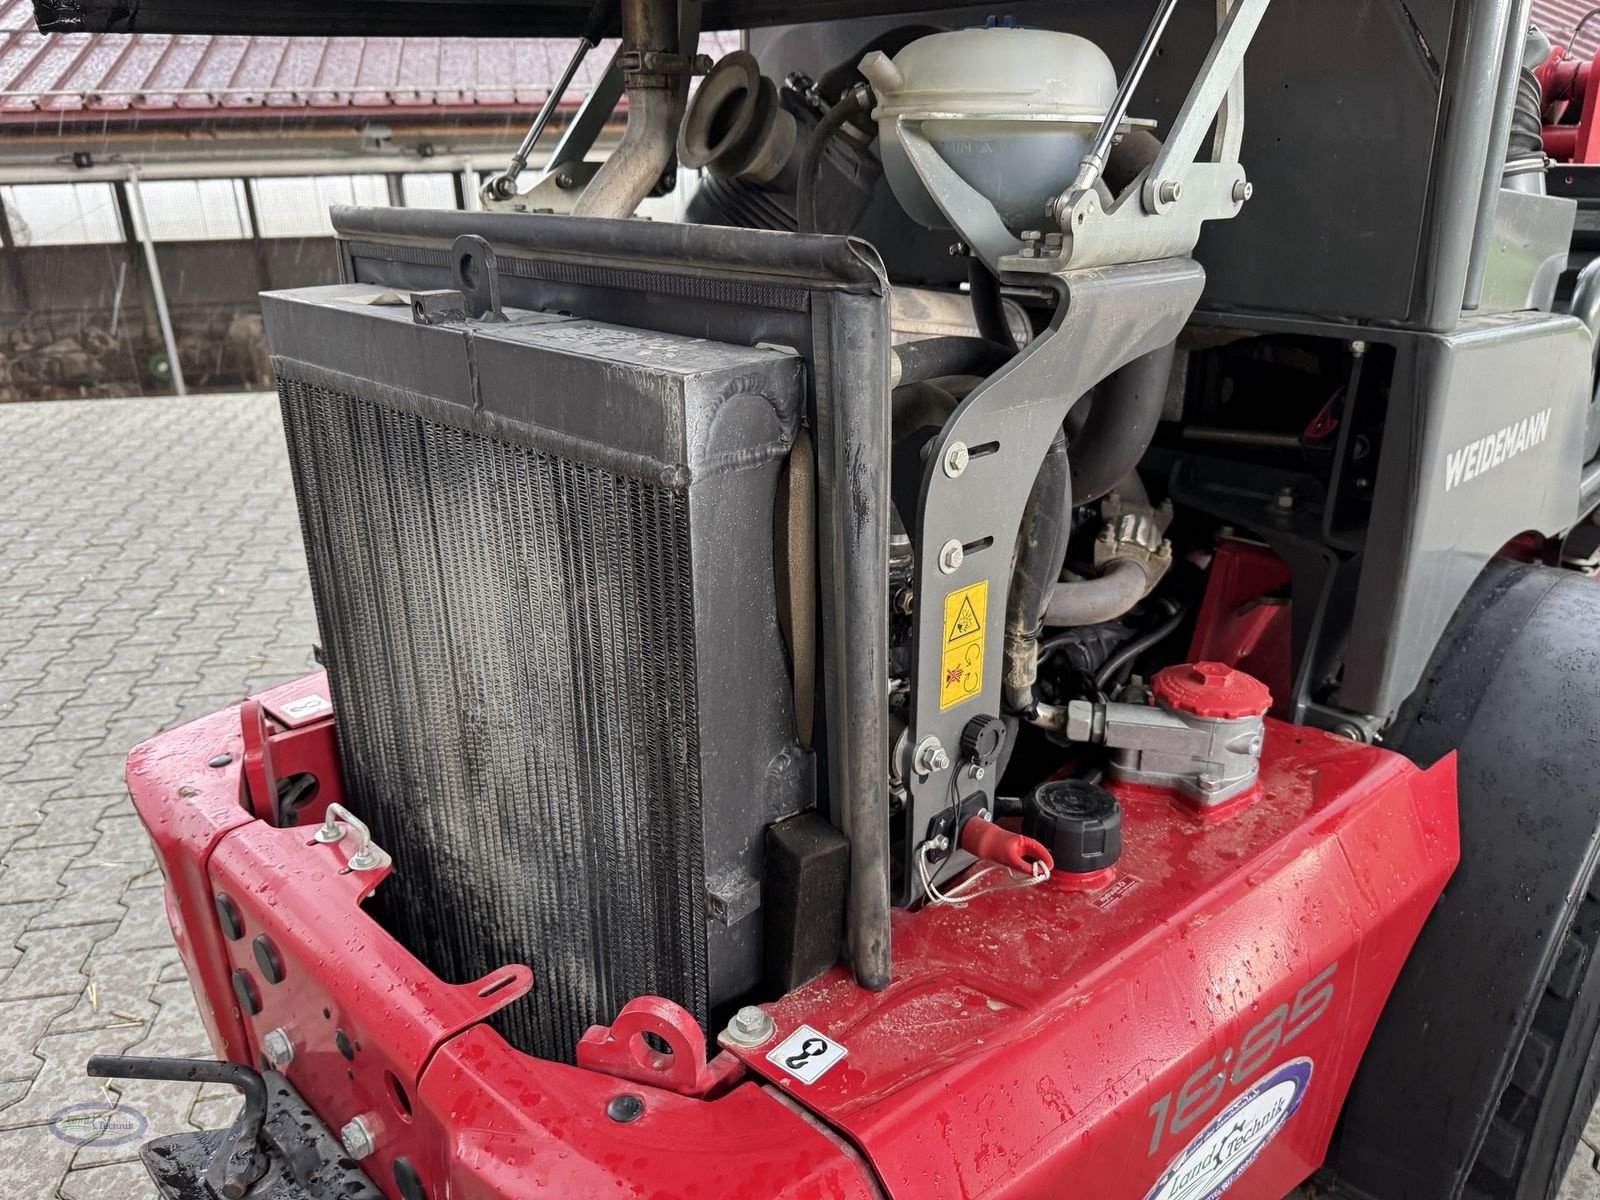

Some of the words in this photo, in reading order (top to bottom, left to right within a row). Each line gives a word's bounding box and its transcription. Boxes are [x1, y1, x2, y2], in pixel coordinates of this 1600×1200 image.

[944, 141, 972, 153] MIN
[1445, 407, 1552, 492] WEIDEMANN
[1168, 1143, 1217, 1199] Land
[1226, 1096, 1285, 1158] Technik
